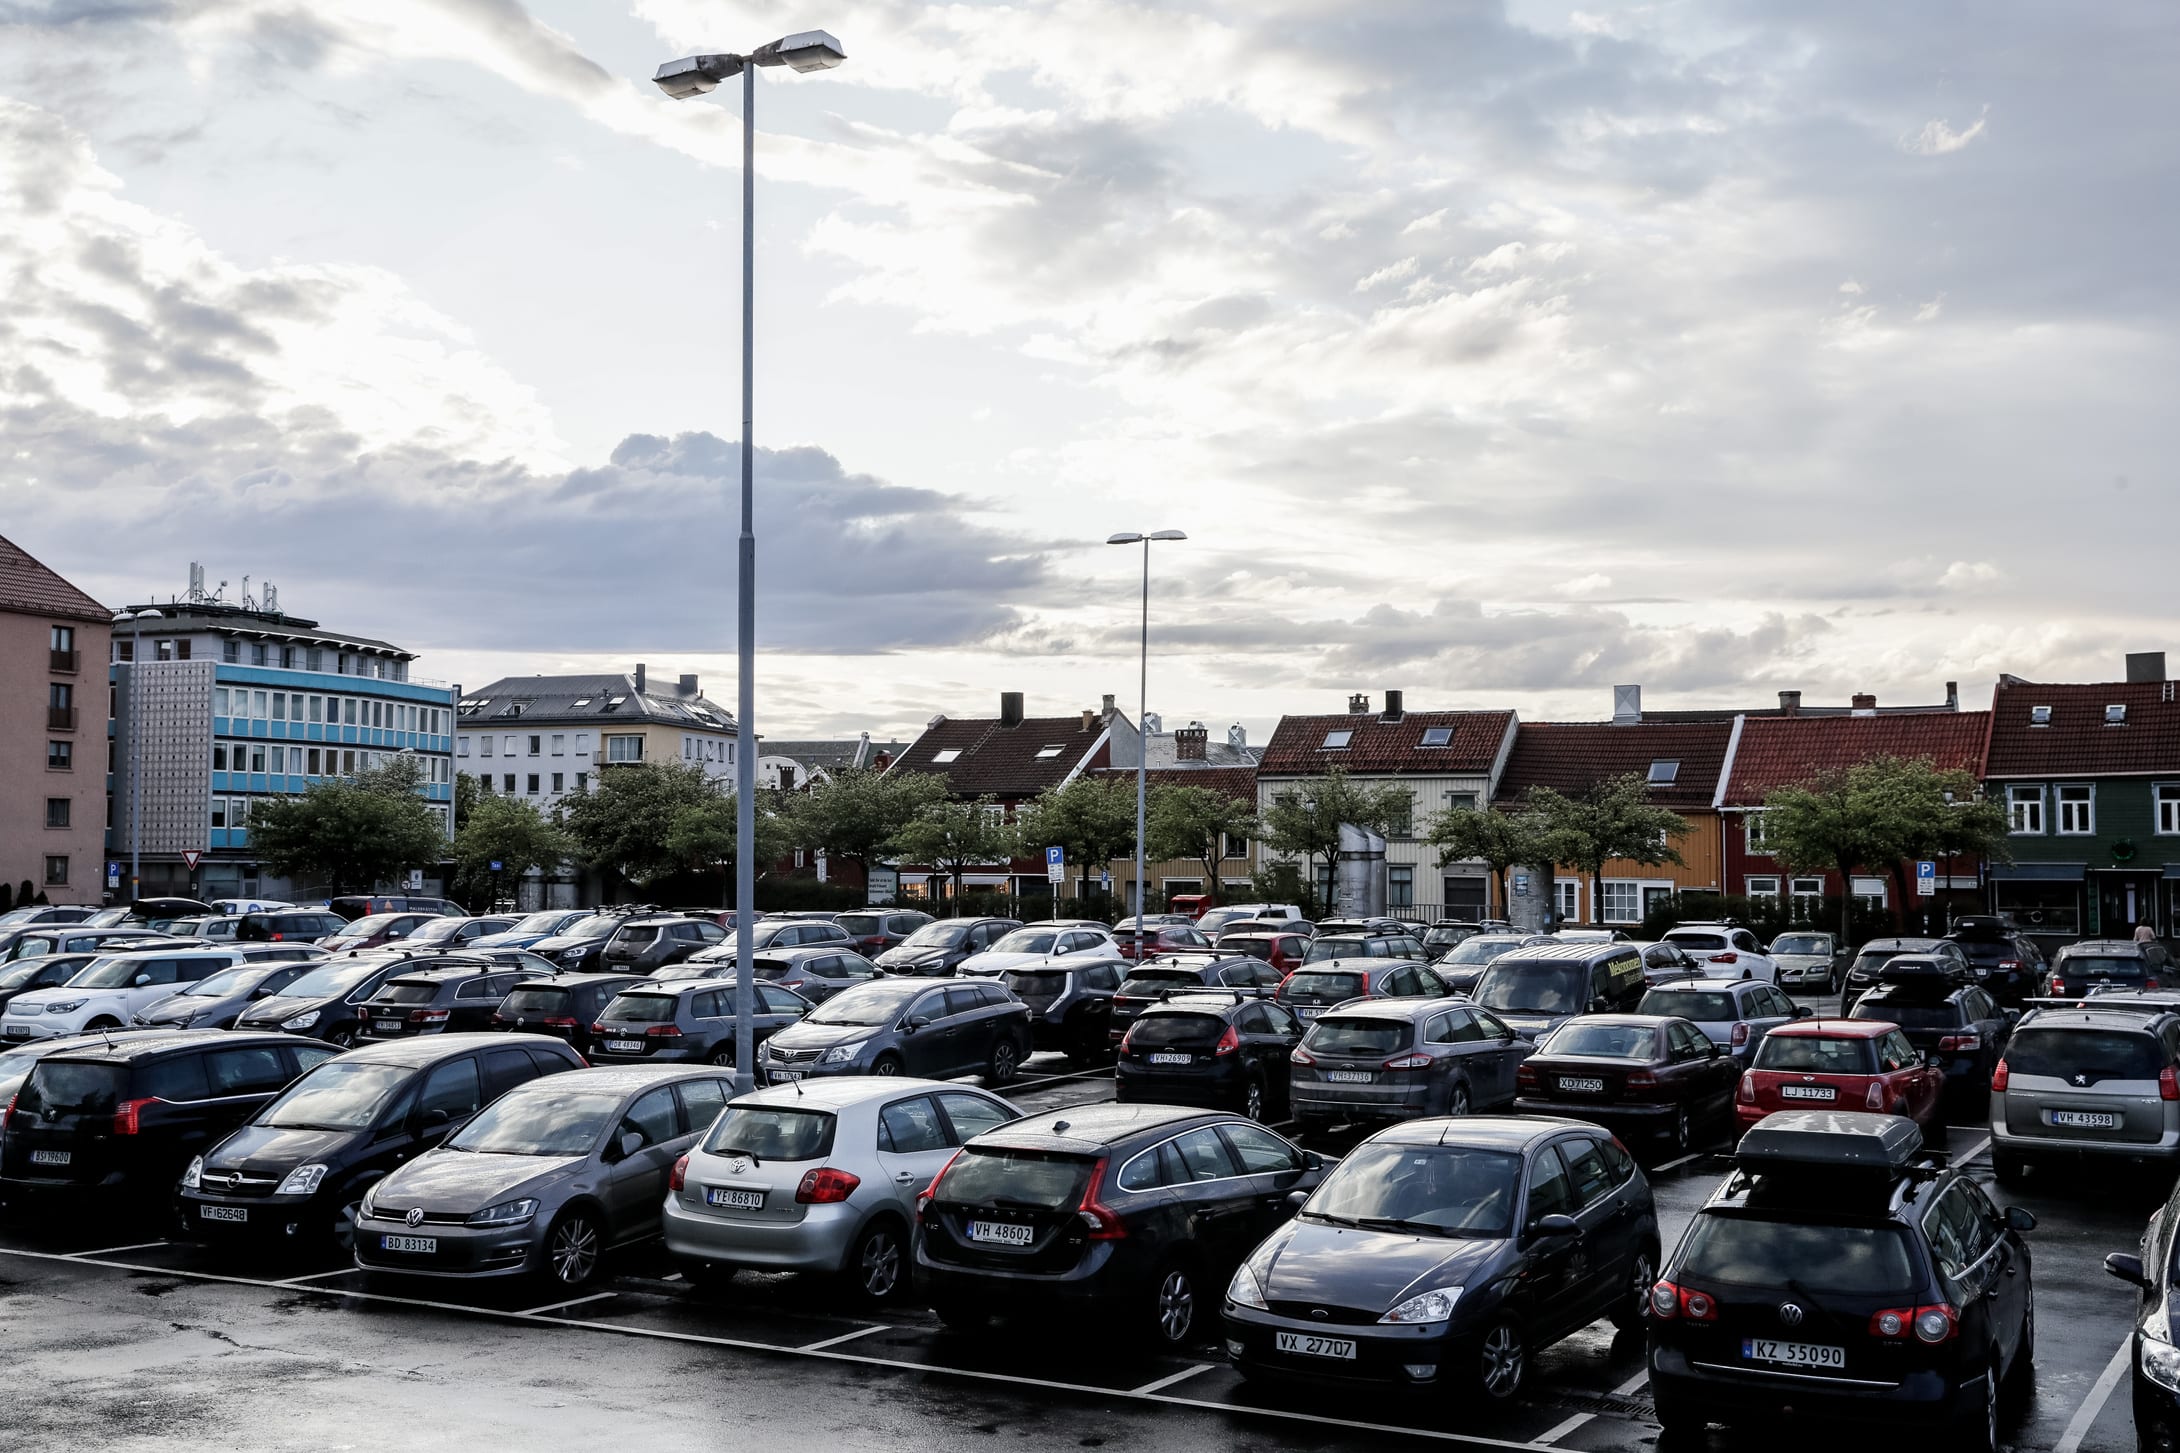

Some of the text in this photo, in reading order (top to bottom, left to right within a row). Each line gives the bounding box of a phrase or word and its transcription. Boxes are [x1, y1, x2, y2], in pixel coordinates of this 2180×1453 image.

[1050, 849, 1059, 862] P
[110, 864, 117, 875] P
[1921, 864, 1931, 877] P
[1607, 957, 1642, 977] Mekonomen
[1785, 1087, 1833, 1098] LJ 11733
[2059, 1113, 2074, 1123] VH
[2078, 1114, 2112, 1125] 43598
[716, 1189, 761, 1206] YE 86810
[202, 1206, 245, 1220] VF 62648
[975, 1223, 1032, 1241] VH 48602
[388, 1237, 434, 1251] BD 83134
[1280, 1334, 1353, 1357] VX 27707
[1756, 1341, 1842, 1365] KZ 55090
